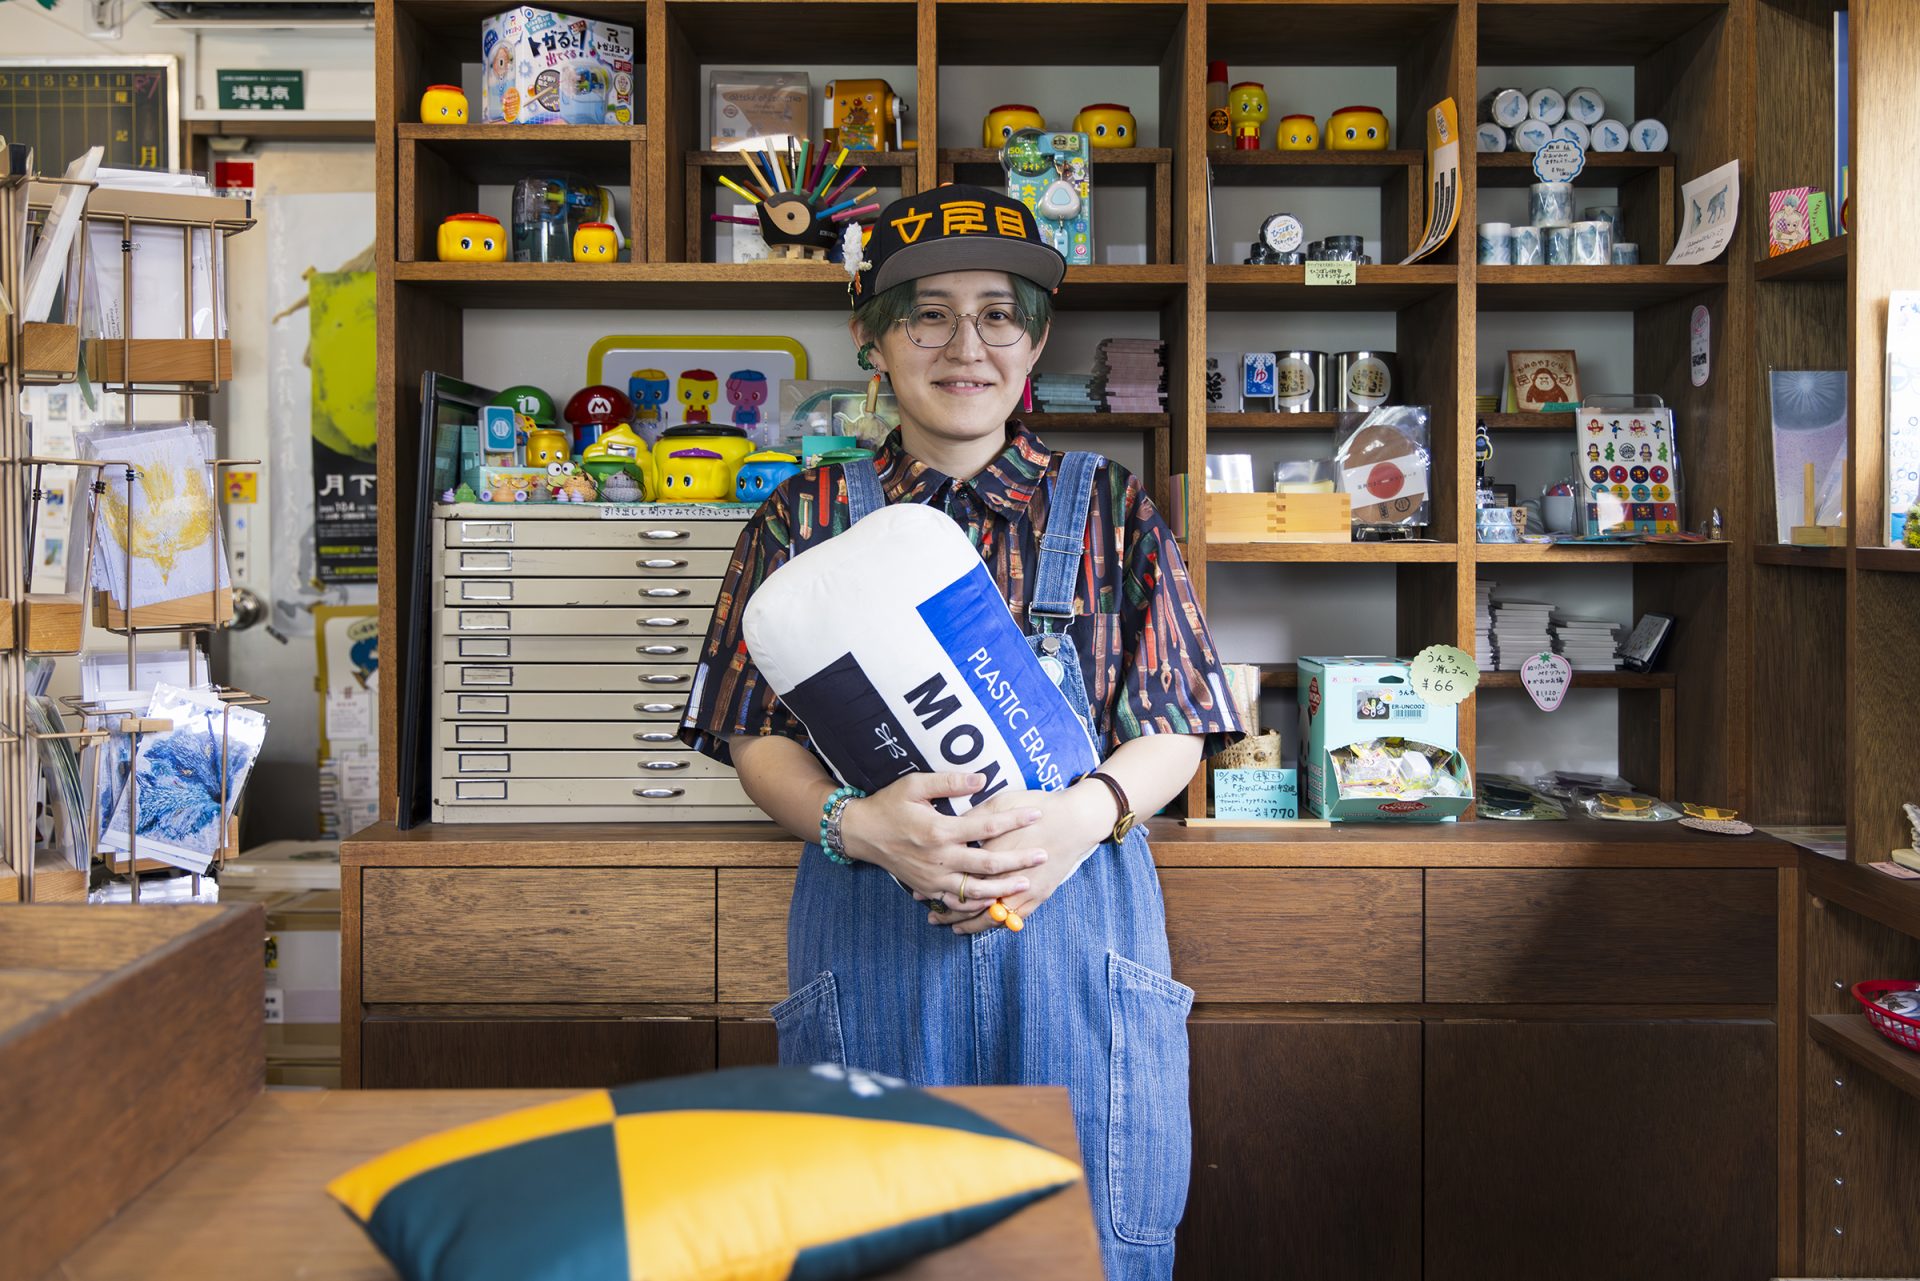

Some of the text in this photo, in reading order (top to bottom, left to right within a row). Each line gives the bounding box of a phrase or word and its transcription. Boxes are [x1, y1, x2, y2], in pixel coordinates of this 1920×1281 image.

[528, 28, 587, 57] トガると!
[597, 41, 631, 55] トガリターン
[545, 49, 577, 67] 出てくる
[140, 146, 157, 168] 月
[525, 400, 535, 413] L
[591, 400, 608, 412] M
[1427, 651, 1456, 663] うんち
[1433, 665, 1469, 677] 消しゴム
[967, 646, 1030, 731] PLASTIC
